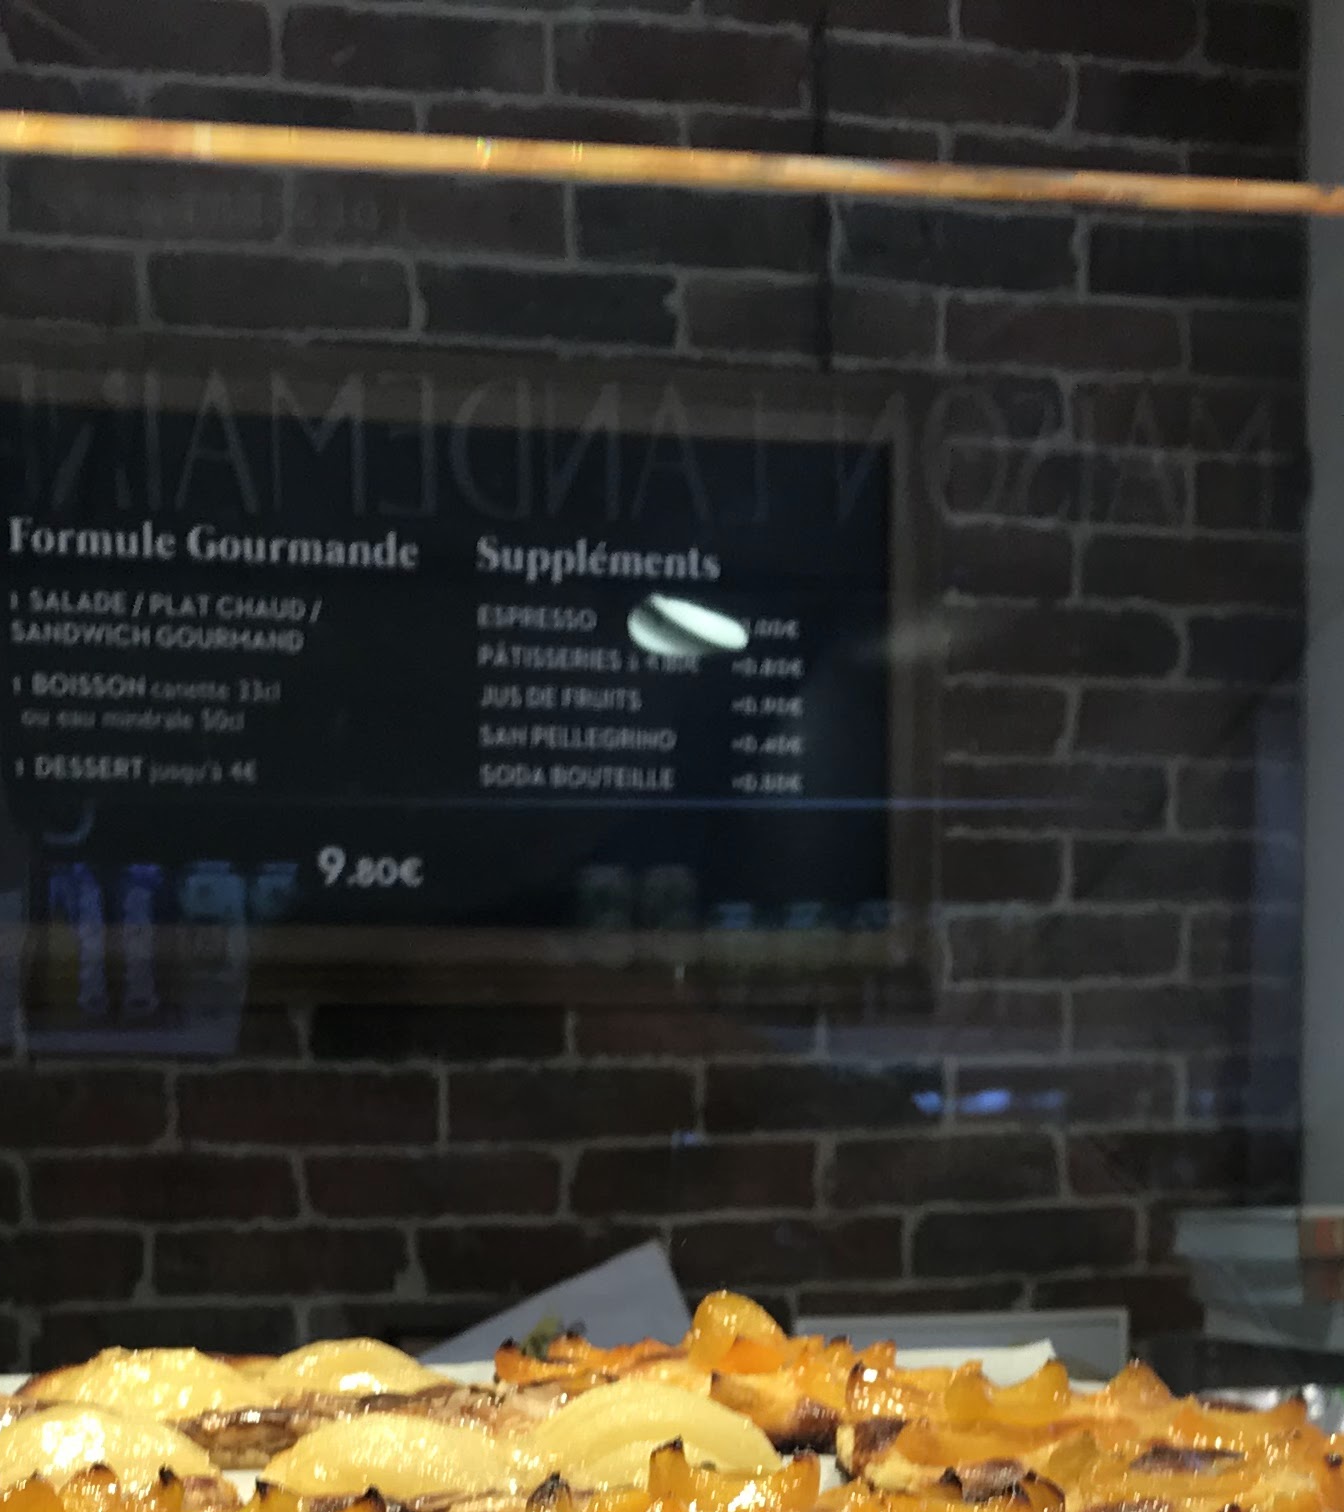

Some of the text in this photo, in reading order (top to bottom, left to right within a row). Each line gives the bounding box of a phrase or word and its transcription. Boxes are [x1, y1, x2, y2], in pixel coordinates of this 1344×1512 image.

[8, 515, 419, 570] Formule Gourmande
[476, 535, 721, 584] Suppléments
[28, 586, 126, 615] SALADE
[148, 592, 210, 617] PLAT
[215, 594, 307, 621] CHAUD
[477, 603, 597, 632] ESPRESSO
[10, 620, 305, 655] SANDWICH GOURMAND
[31, 672, 146, 698] BOISSON
[480, 684, 642, 712] JUS DE FRUITS
[478, 724, 678, 751] SAN PELLEGRINO
[34, 755, 143, 781] DESSERT
[478, 762, 675, 791] SODA BOUTEILLE
[317, 845, 424, 888] 9.80€
